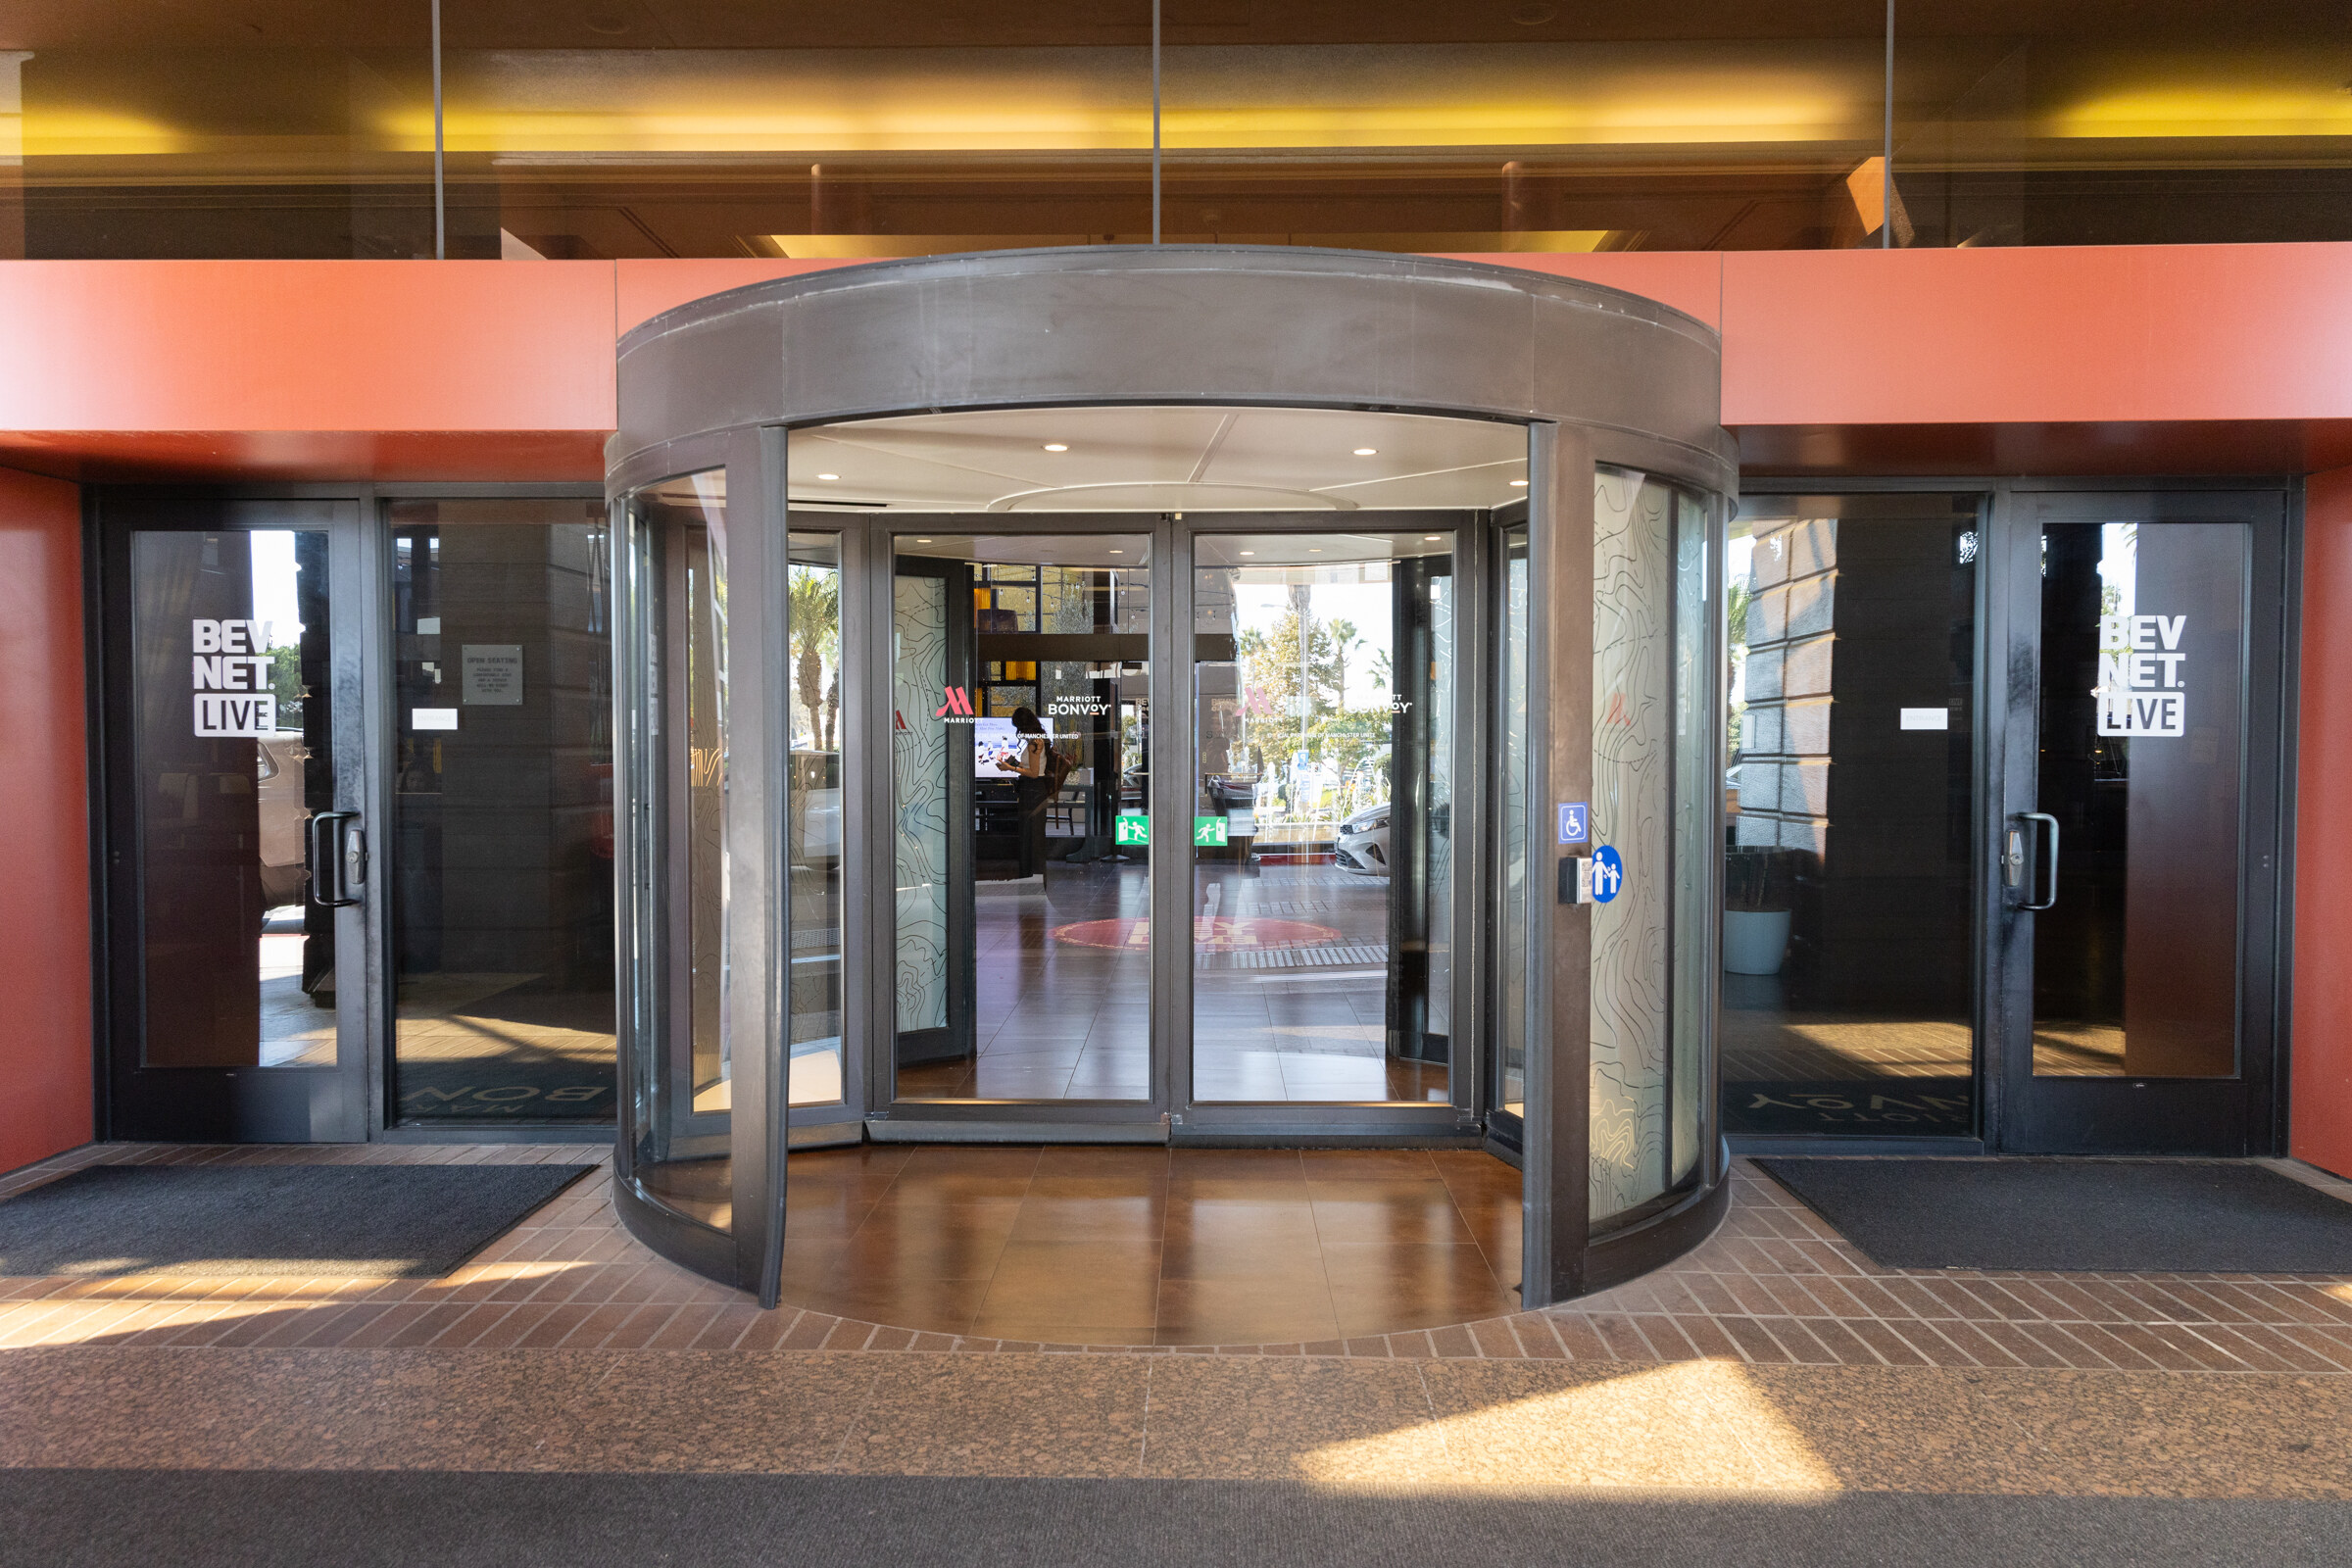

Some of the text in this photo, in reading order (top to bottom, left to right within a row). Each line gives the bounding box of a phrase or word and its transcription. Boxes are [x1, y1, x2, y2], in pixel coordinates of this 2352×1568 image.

[193, 619, 273, 653] BEV
[2099, 614, 2186, 650] BEV
[202, 700, 270, 730] LIVE
[1048, 704, 1108, 715] BONVOY
[2106, 698, 2178, 730] LIVE
